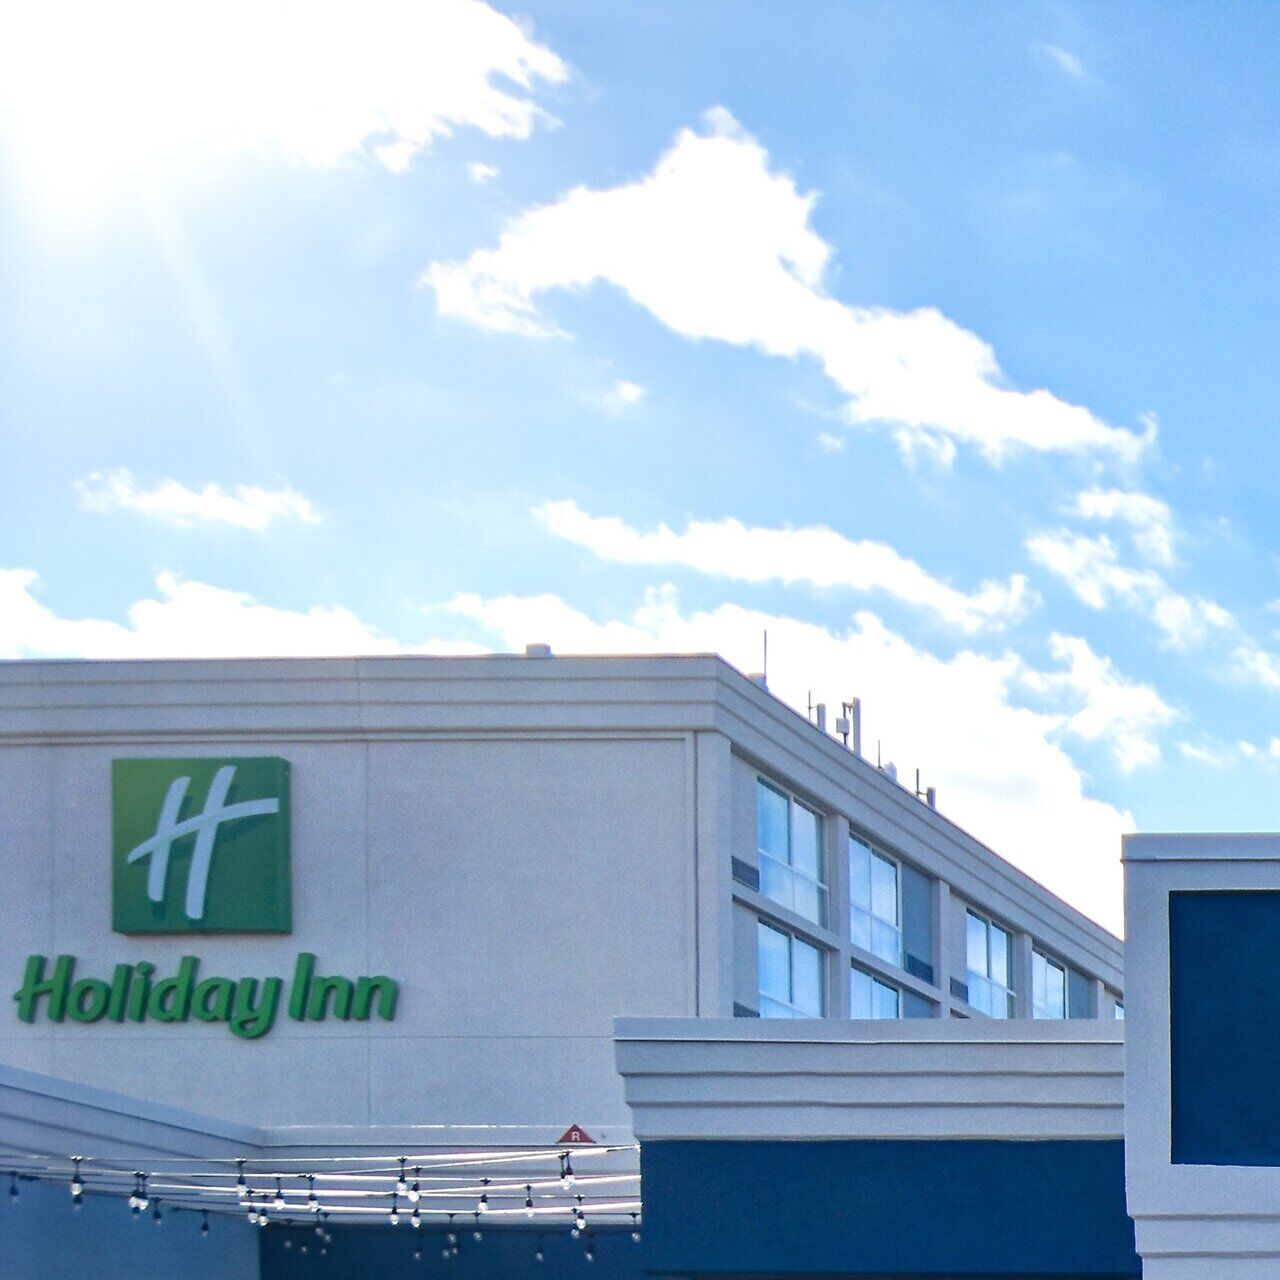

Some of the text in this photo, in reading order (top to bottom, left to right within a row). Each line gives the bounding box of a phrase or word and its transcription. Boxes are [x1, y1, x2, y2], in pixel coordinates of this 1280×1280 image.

[126, 765, 279, 920] H
[14, 952, 399, 1039] Holiday Inn
[572, 1131, 580, 1142] R
